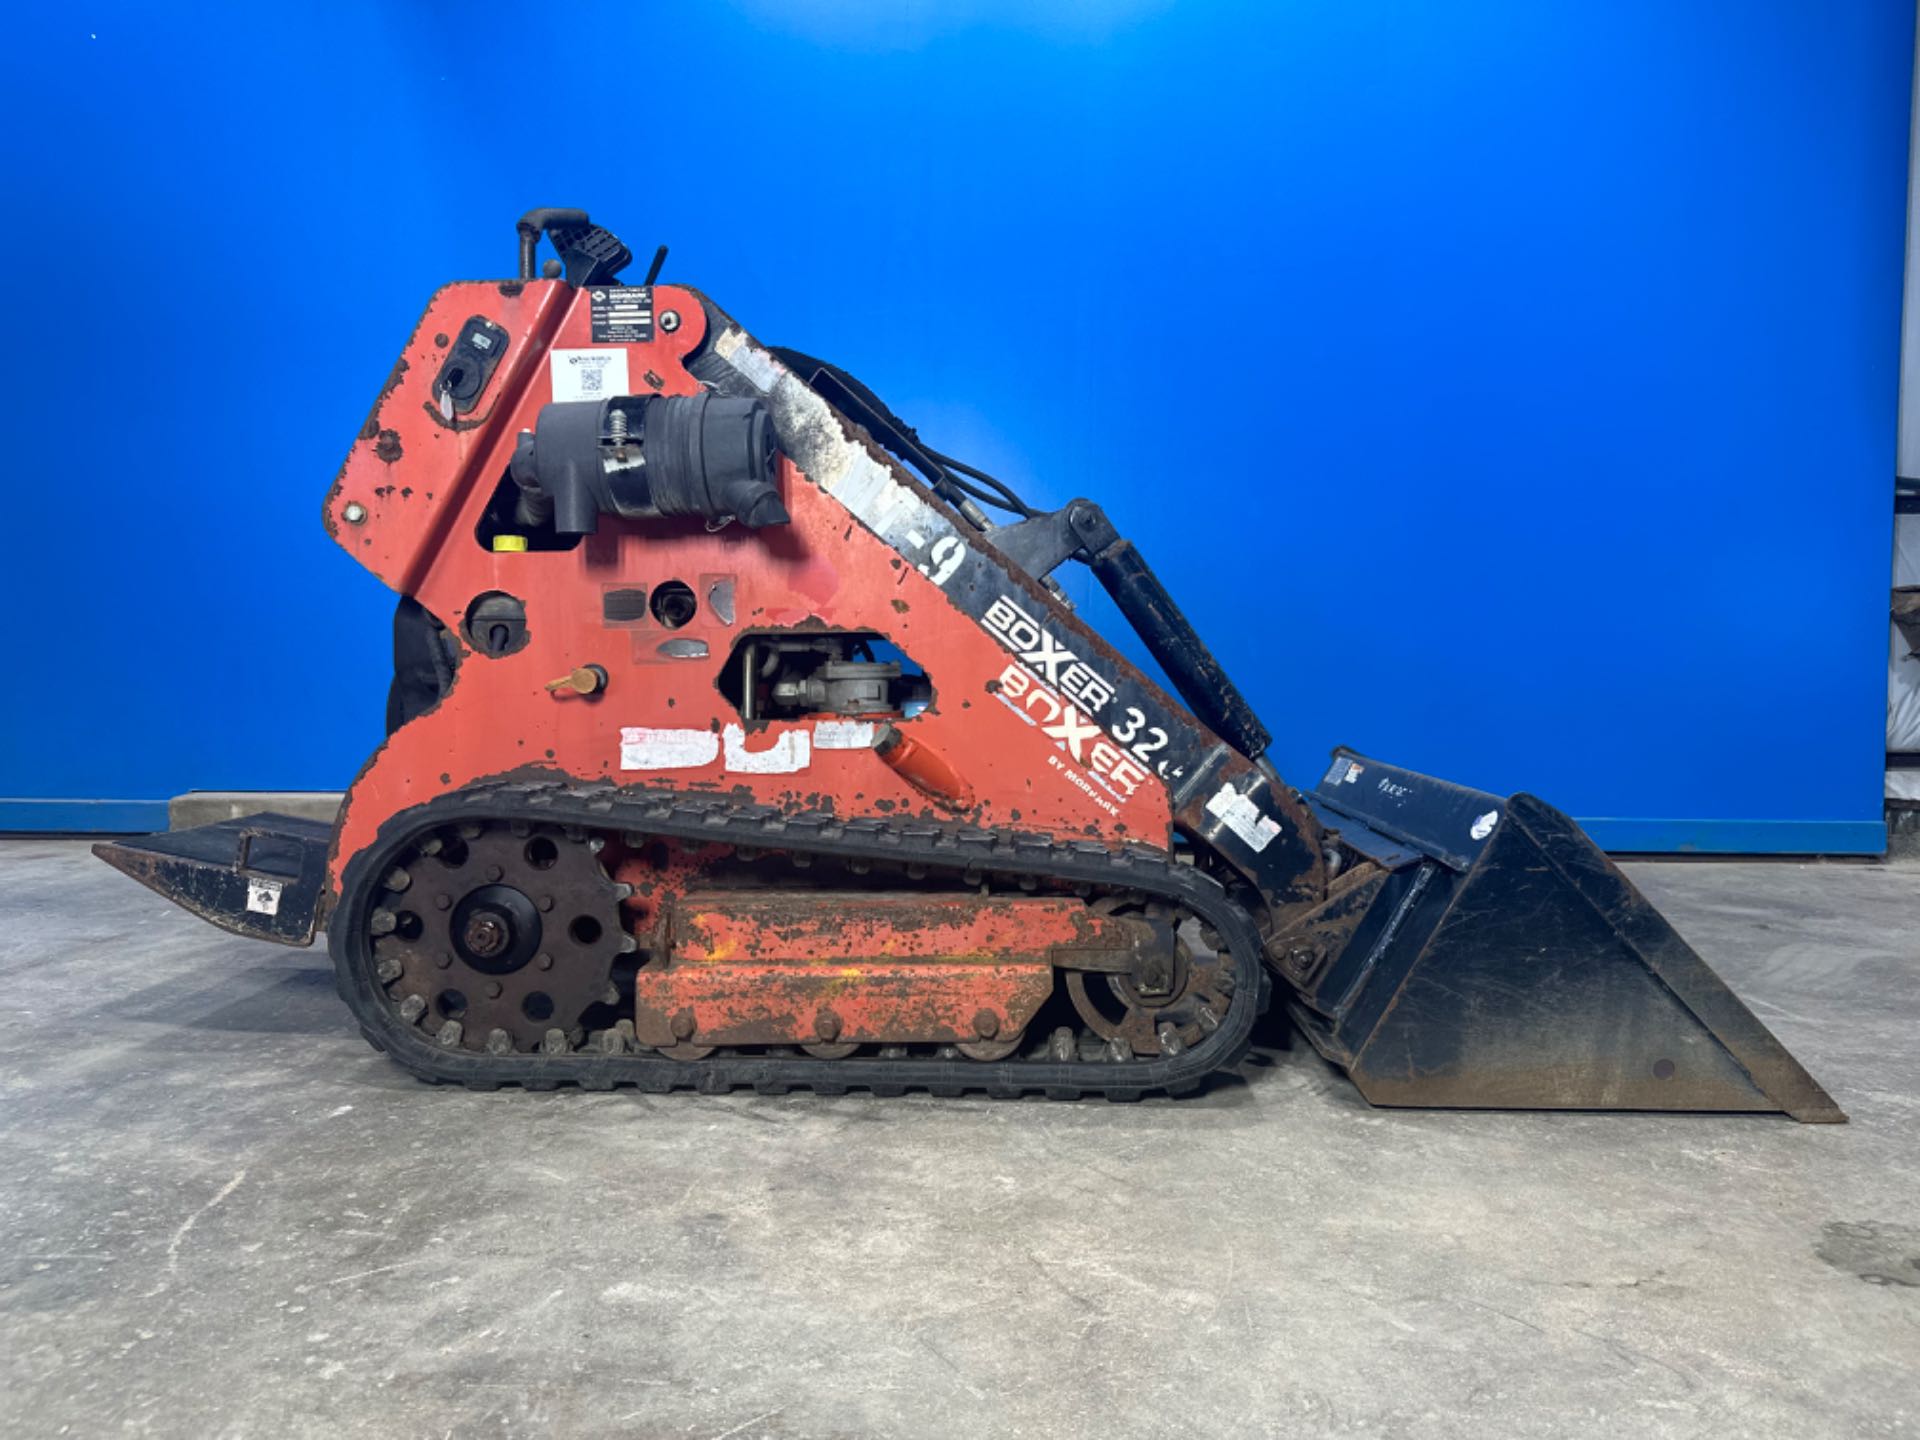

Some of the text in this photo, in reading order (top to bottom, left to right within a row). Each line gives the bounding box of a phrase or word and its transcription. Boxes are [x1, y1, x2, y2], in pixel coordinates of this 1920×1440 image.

[981, 595, 1115, 715] BOXER
[999, 664, 1145, 796] BOXER
[1048, 755, 1065, 771] BY
